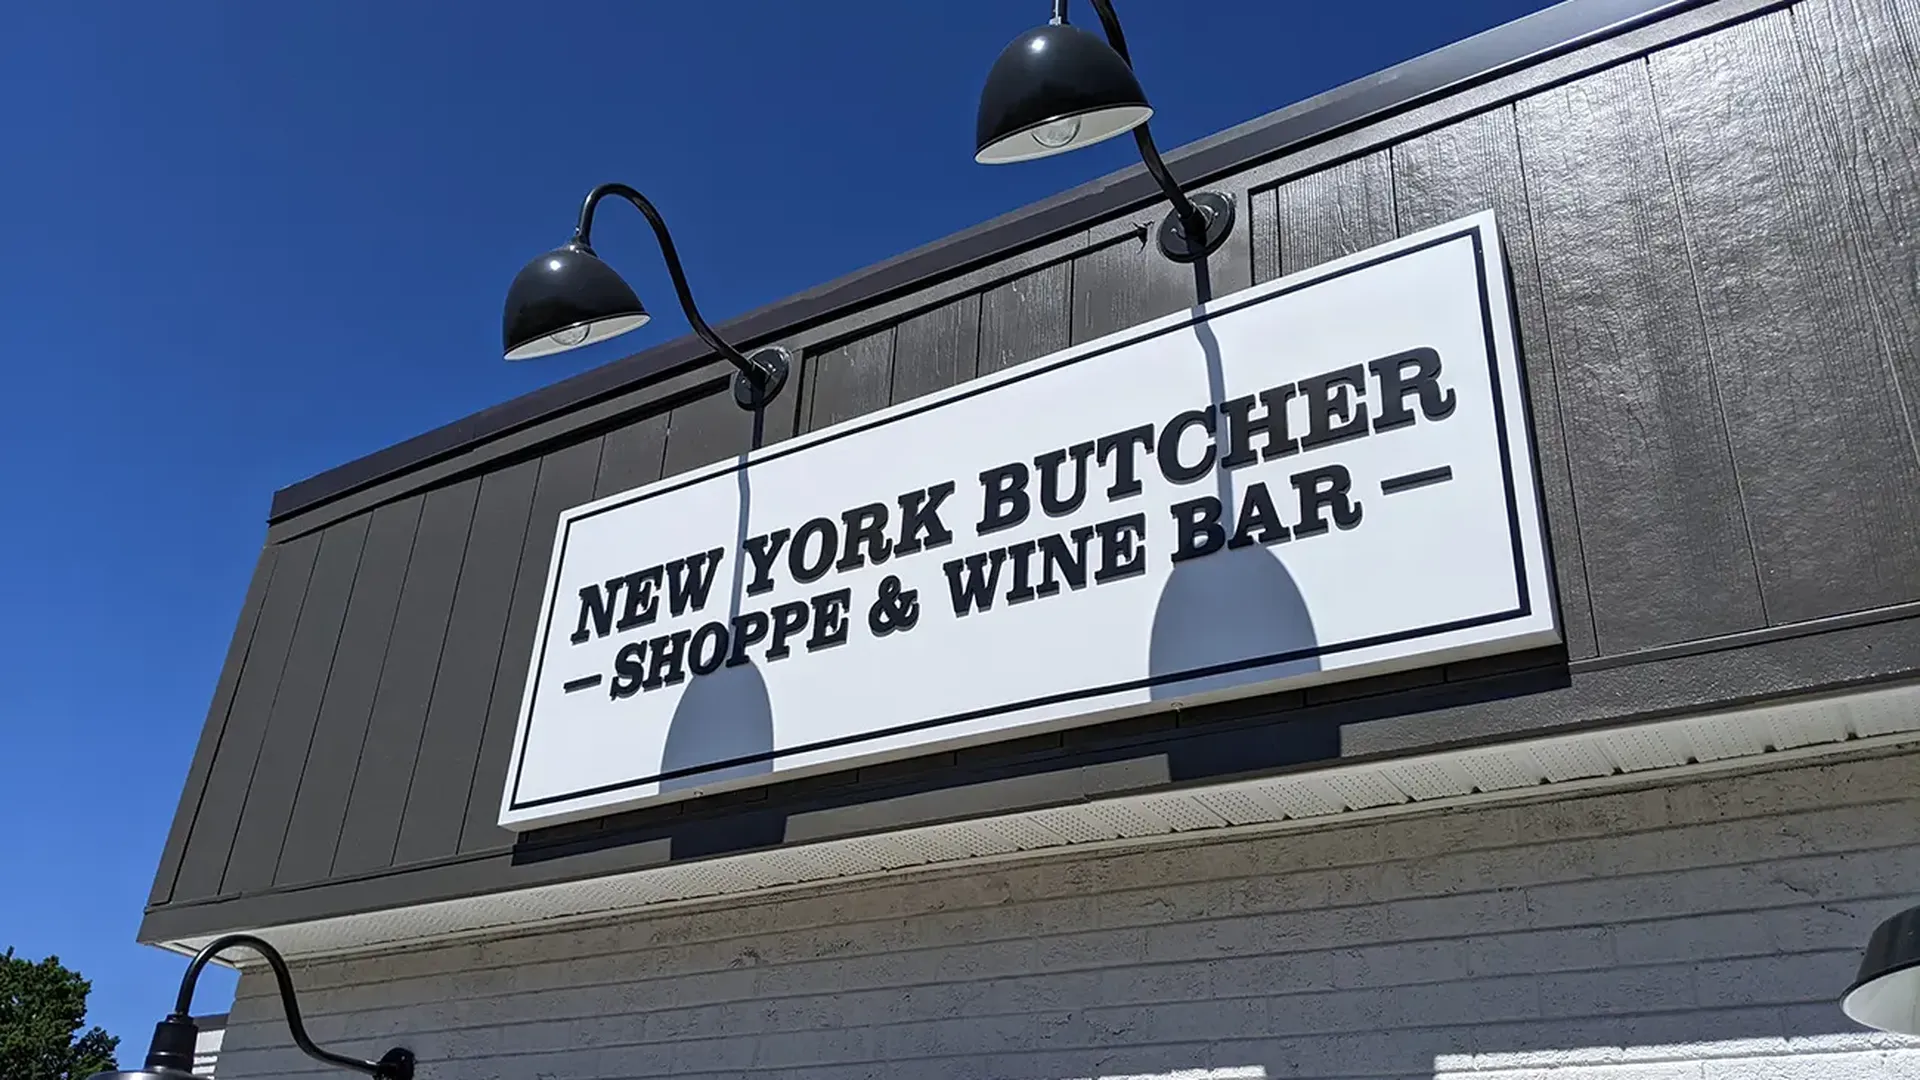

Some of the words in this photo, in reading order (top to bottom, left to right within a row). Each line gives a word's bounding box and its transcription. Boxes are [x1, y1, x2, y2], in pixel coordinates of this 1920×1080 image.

[570, 546, 724, 645] NEW
[743, 481, 955, 597] YORK
[976, 346, 1457, 536] BUTCHER
[610, 587, 851, 700] SHOPPE
[867, 575, 920, 637] &
[943, 513, 1146, 619] WINE
[1171, 464, 1363, 567] BAR
